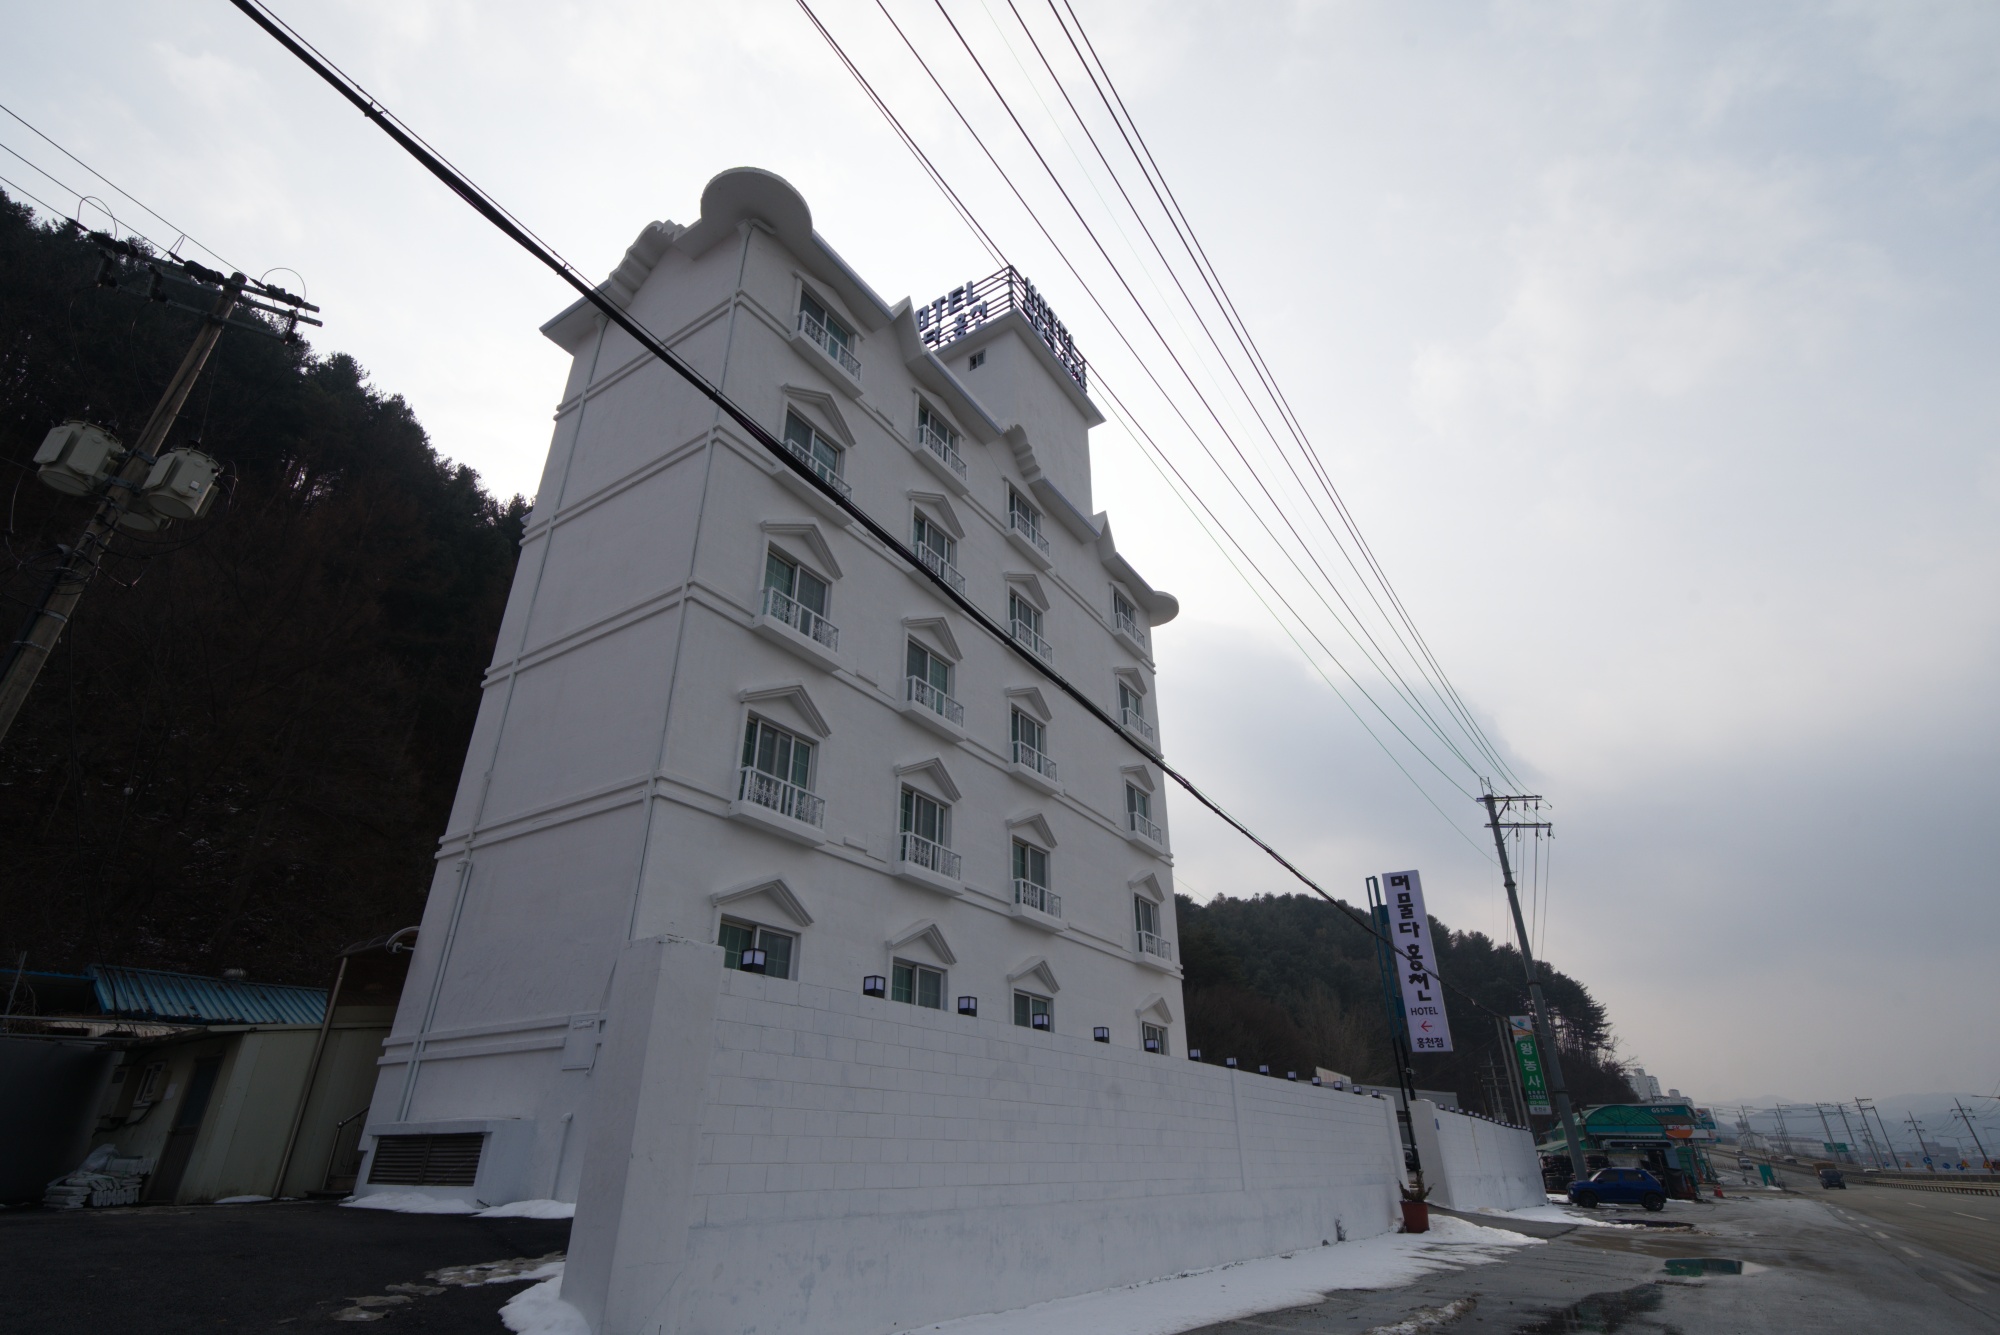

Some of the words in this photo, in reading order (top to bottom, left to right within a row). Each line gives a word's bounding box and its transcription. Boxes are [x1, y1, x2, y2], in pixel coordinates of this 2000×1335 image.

[1390, 875, 1421, 938] 머물다
[1407, 943, 1432, 1002] 홍천
[1410, 1006, 1439, 1016] HOTEL
[1416, 1036, 1445, 1049] 홍천점
